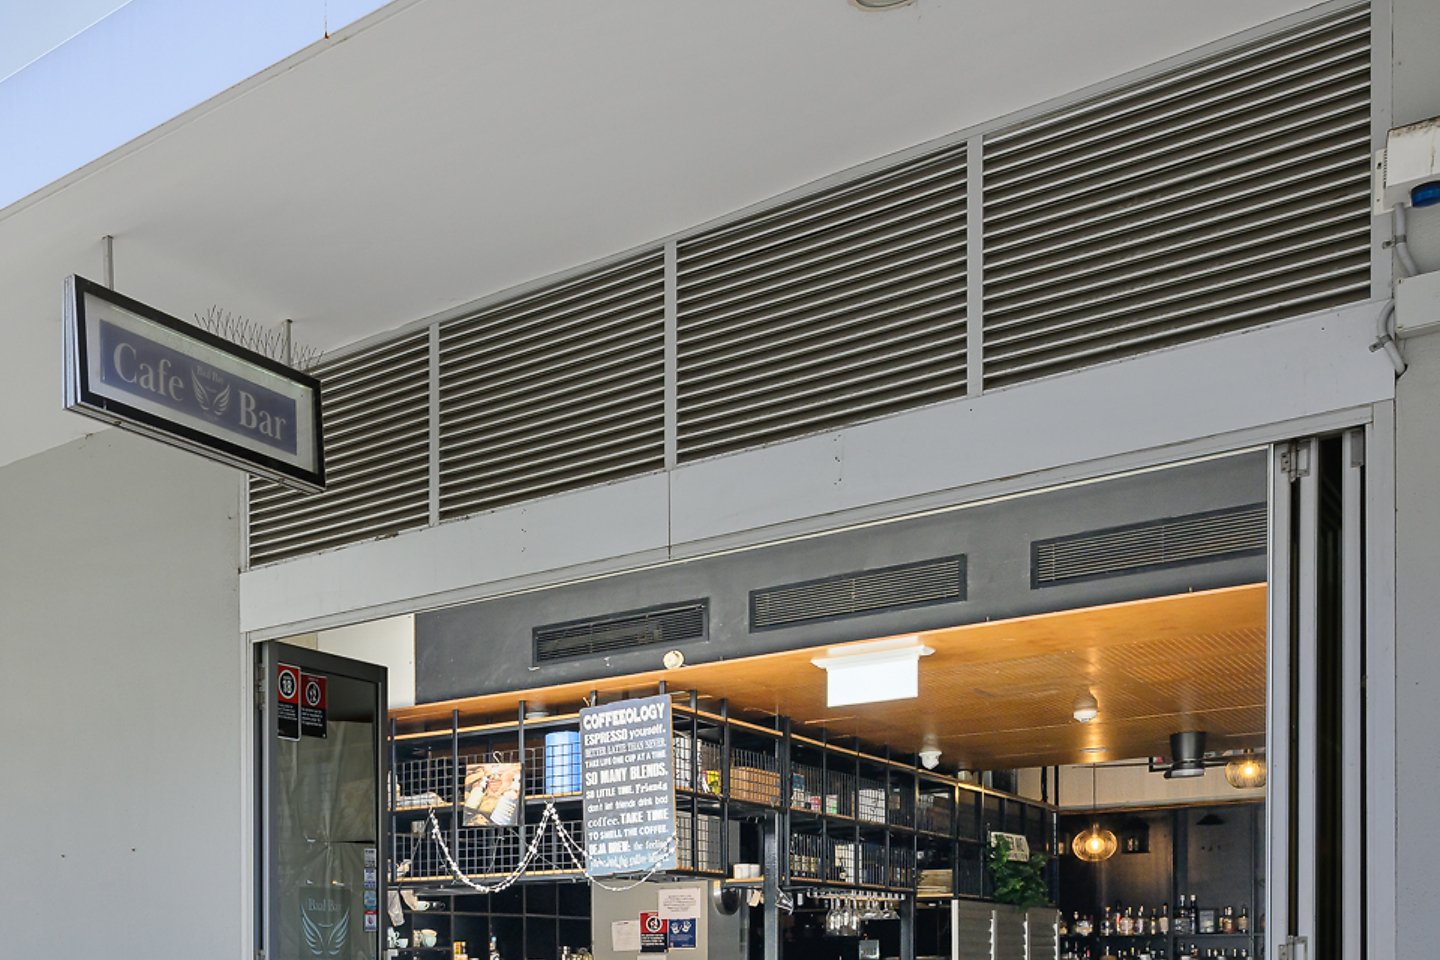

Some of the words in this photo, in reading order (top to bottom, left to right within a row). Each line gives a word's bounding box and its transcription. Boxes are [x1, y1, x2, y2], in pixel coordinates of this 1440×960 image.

[113, 342, 184, 402] Cafe
[238, 389, 287, 441] Bar
[583, 703, 665, 730] COFFEEOLOGY
[584, 728, 627, 746] ESPRESSO
[625, 753, 636, 763] CUP
[637, 752, 645, 761] AT
[646, 751, 652, 760] A
[585, 771, 598, 786] SO
[600, 767, 627, 784] MANY
[586, 789, 595, 800] SO
[596, 787, 616, 798] LITTLE
[635, 781, 668, 795] Friends
[654, 795, 668, 805] bad
[620, 811, 644, 825] TAKE
[646, 808, 670, 821] TIME
[588, 831, 599, 841] TO
[600, 829, 622, 841] SMELL
[623, 827, 637, 838] THE
